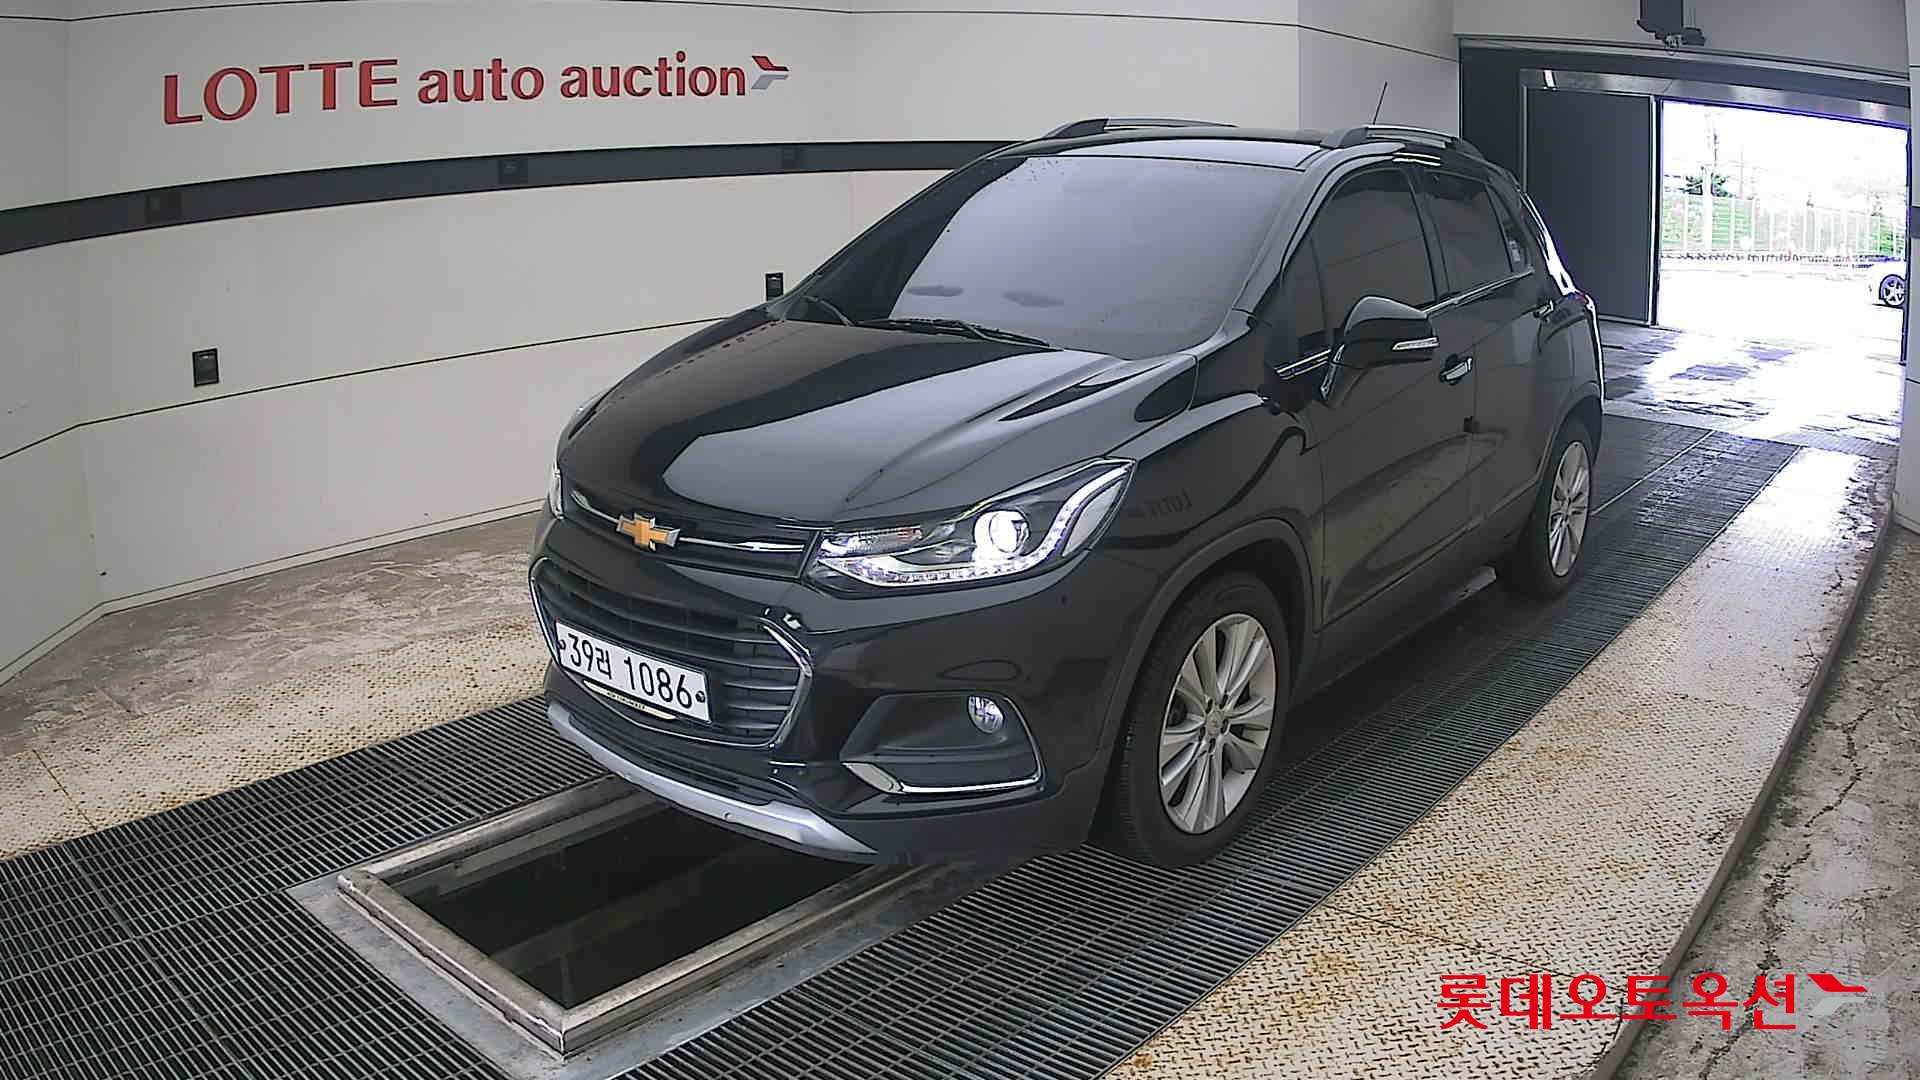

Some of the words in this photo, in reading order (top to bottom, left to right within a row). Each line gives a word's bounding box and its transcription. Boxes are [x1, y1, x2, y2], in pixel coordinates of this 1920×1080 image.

[163, 58, 399, 125] LOTTE
[417, 58, 545, 104] auto
[561, 51, 746, 98] auction
[567, 632, 613, 680] 39러
[623, 655, 693, 709] 1086
